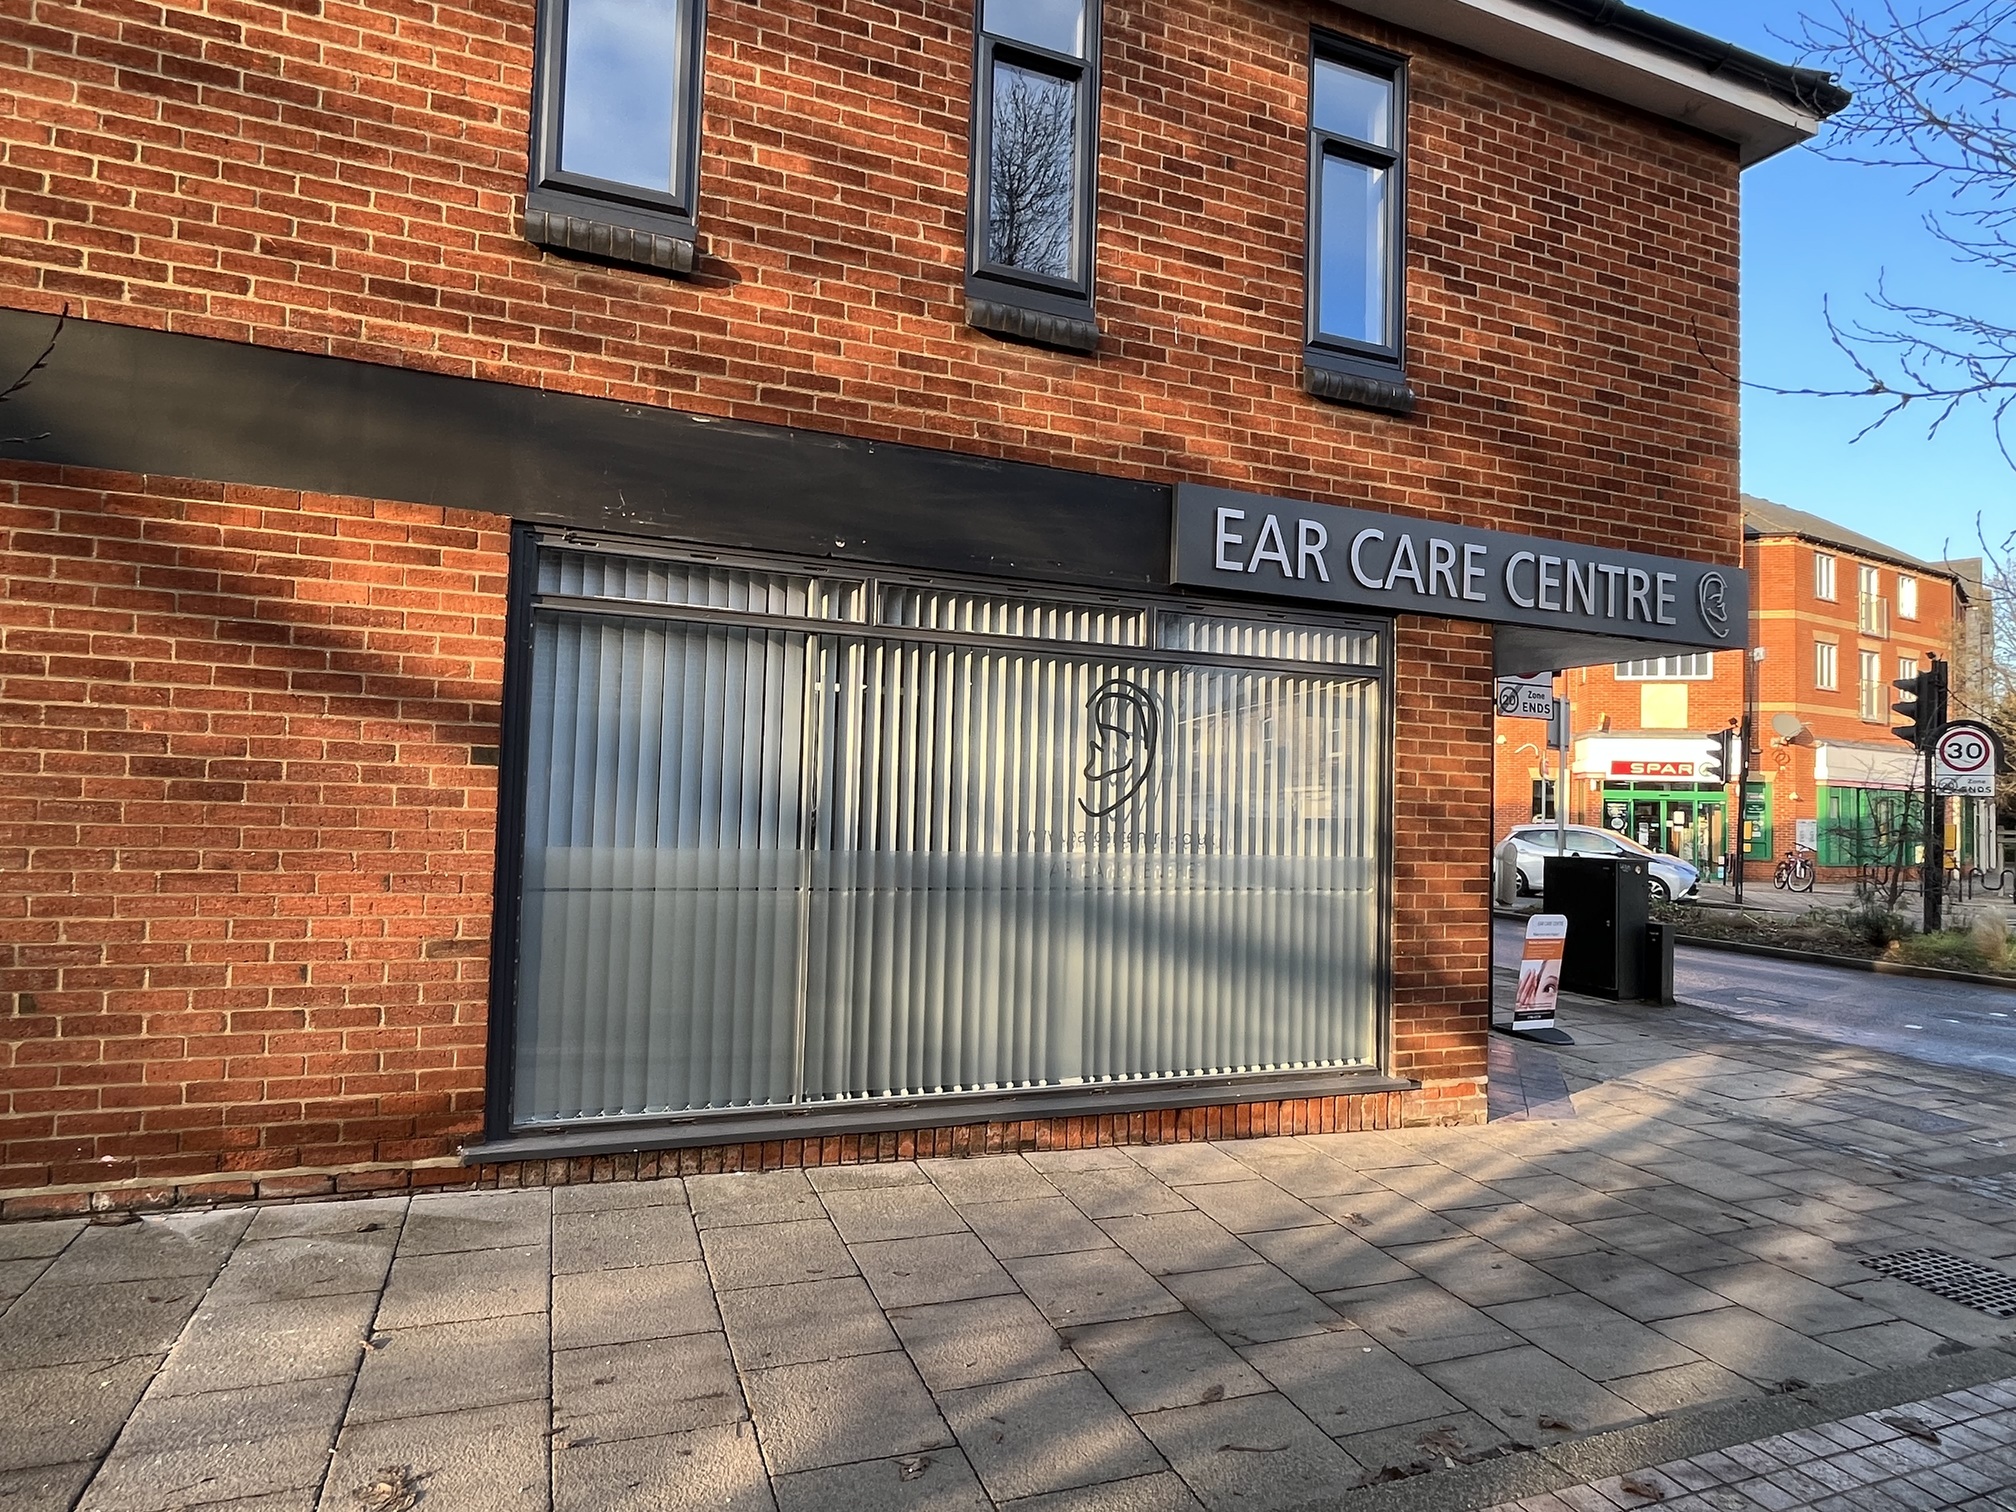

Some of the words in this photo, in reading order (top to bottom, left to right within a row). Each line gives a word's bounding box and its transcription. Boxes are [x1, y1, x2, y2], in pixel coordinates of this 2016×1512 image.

[1214, 506, 1331, 583] EAR
[1350, 528, 1488, 602] CARE
[1505, 551, 1677, 626] CENTRE
[1502, 694, 1516, 707] 20
[1527, 690, 1545, 700] Zone
[1522, 702, 1551, 714] ENDS
[1947, 742, 1983, 759] 30
[1629, 762, 1694, 775] SPAR
